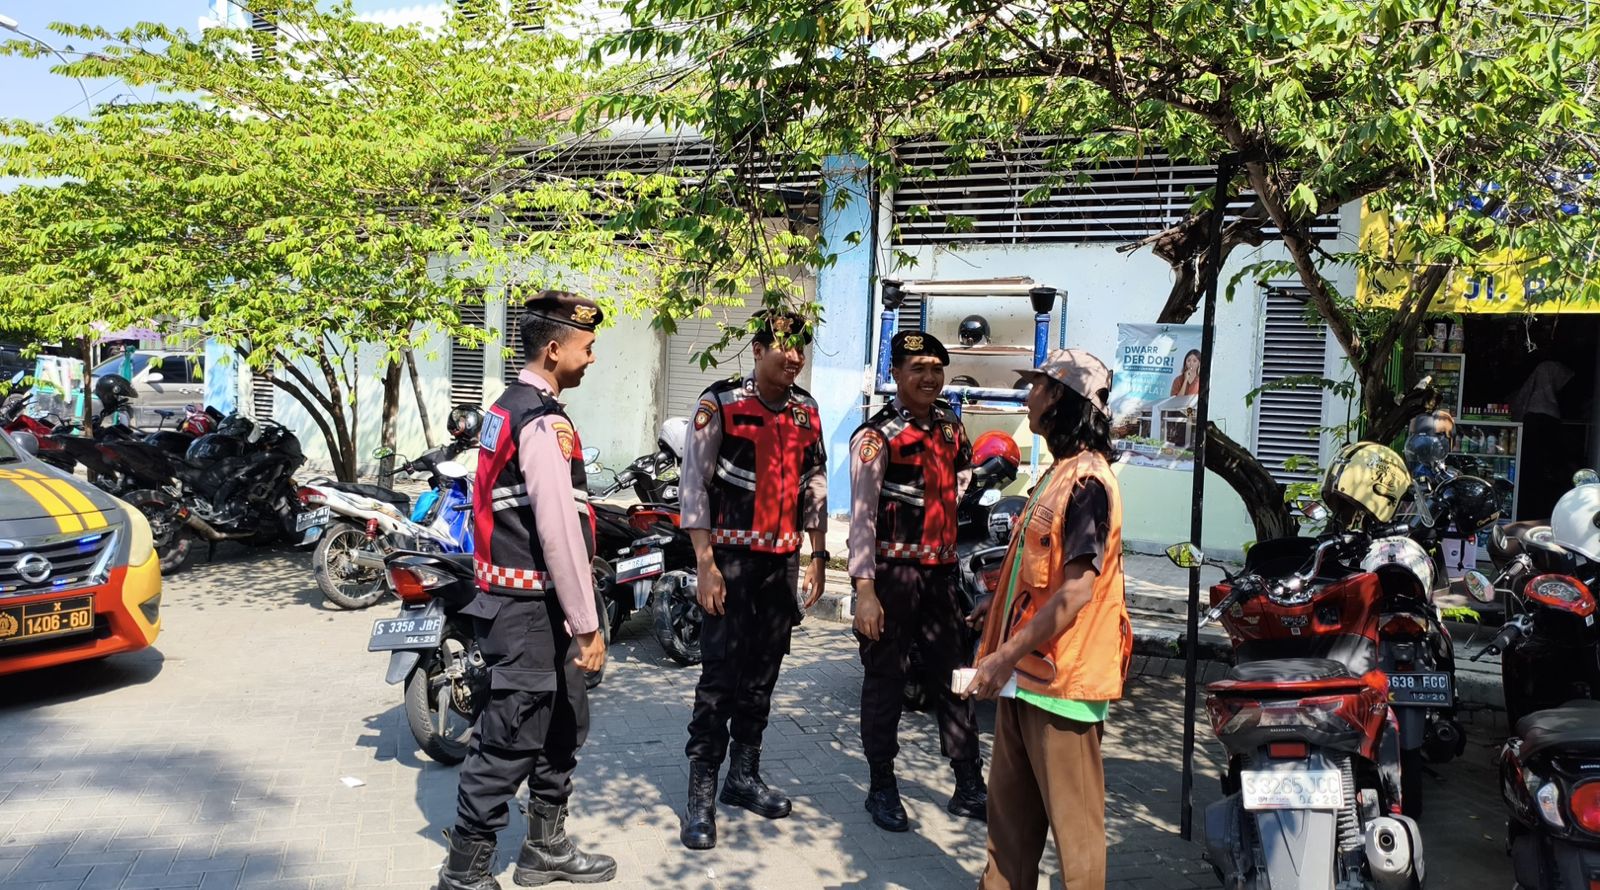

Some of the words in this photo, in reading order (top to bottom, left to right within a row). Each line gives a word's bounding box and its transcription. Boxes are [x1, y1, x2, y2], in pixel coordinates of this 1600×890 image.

[1124, 345, 1159, 354] DWARR
[1123, 354, 1145, 365] DER
[1147, 356, 1175, 366] DOR!
[388, 620, 415, 633] 3358
[1260, 777, 1304, 794] 3265
